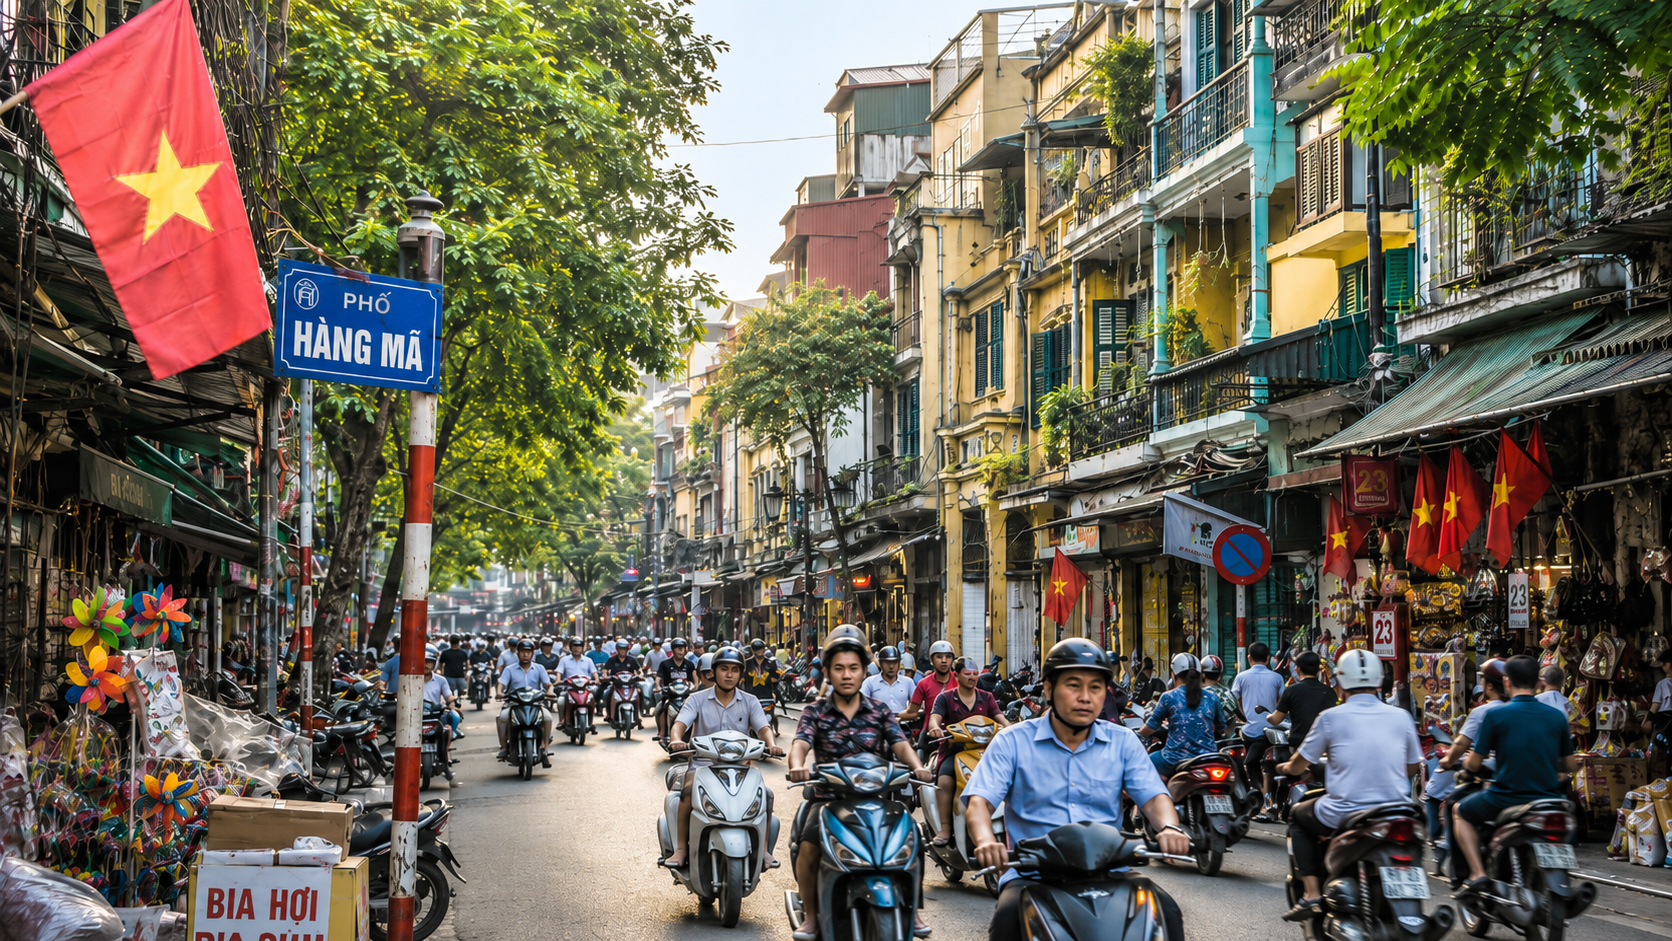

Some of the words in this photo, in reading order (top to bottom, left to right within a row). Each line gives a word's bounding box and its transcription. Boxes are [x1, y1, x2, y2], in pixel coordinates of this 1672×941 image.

[344, 291, 391, 314] PHỐ
[293, 316, 372, 365] HÀNG
[380, 329, 423, 371] MÃ
[1356, 469, 1387, 493] 23
[1510, 583, 1527, 607] 23
[1375, 619, 1393, 645] 23
[206, 887, 255, 920] BIA
[269, 886, 318, 925] HỢI
